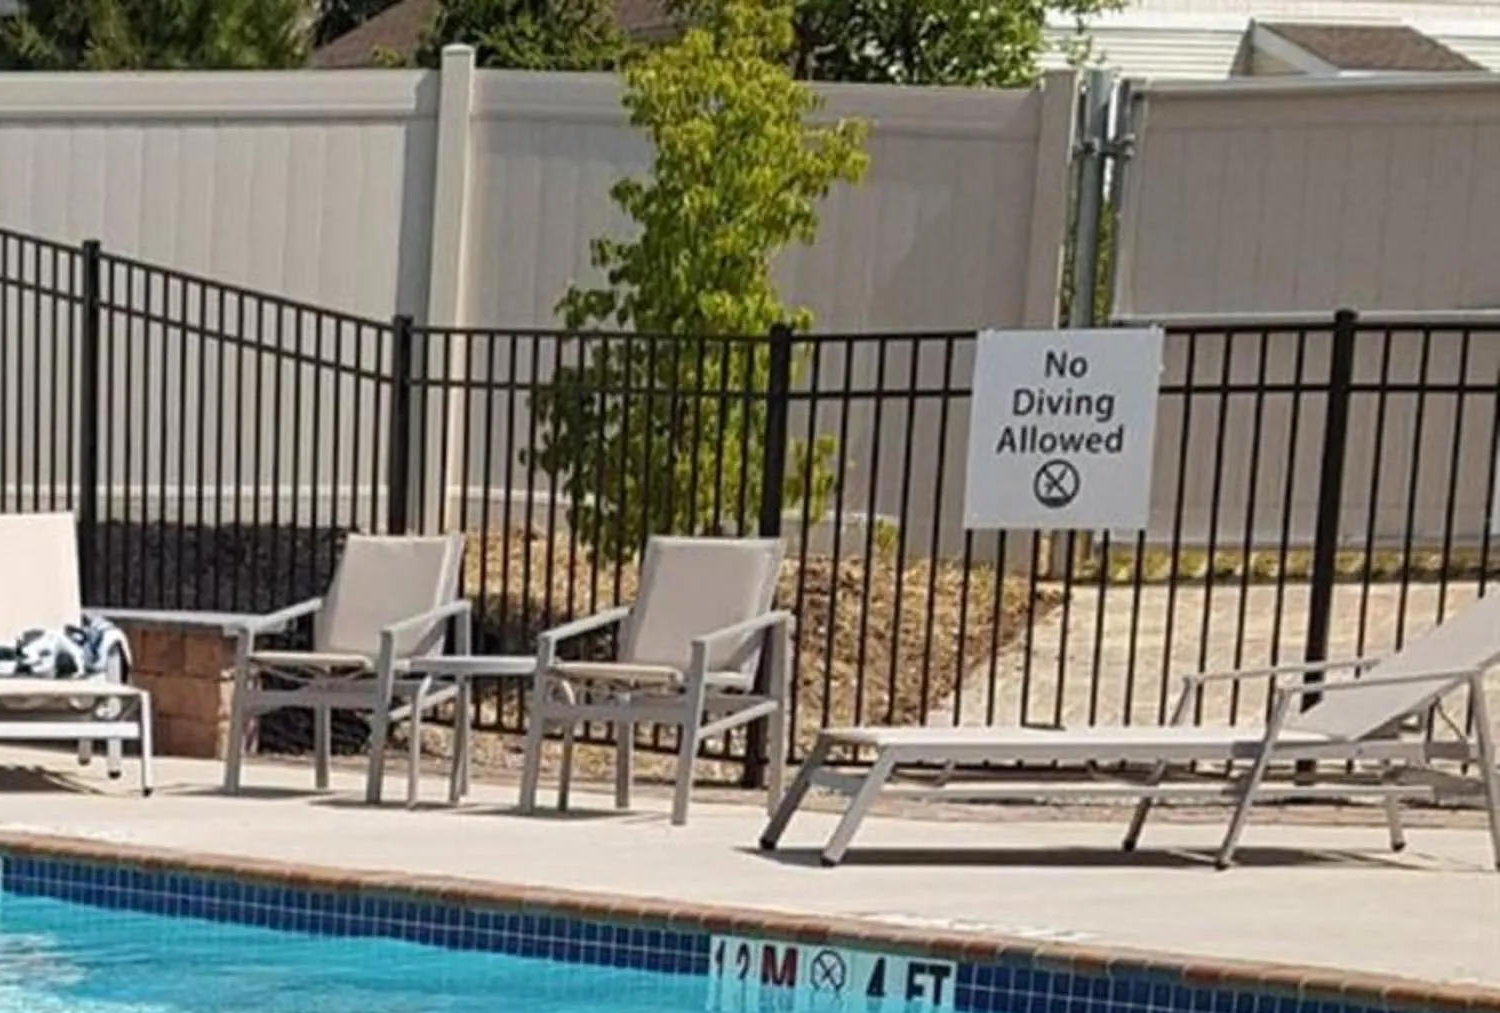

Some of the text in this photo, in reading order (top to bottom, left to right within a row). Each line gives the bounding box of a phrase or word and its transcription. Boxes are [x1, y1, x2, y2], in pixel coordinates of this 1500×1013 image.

[1045, 350, 1088, 379] No
[1012, 387, 1116, 422] Diving
[996, 424, 1125, 454] Allowed
[906, 960, 952, 1006] FT
